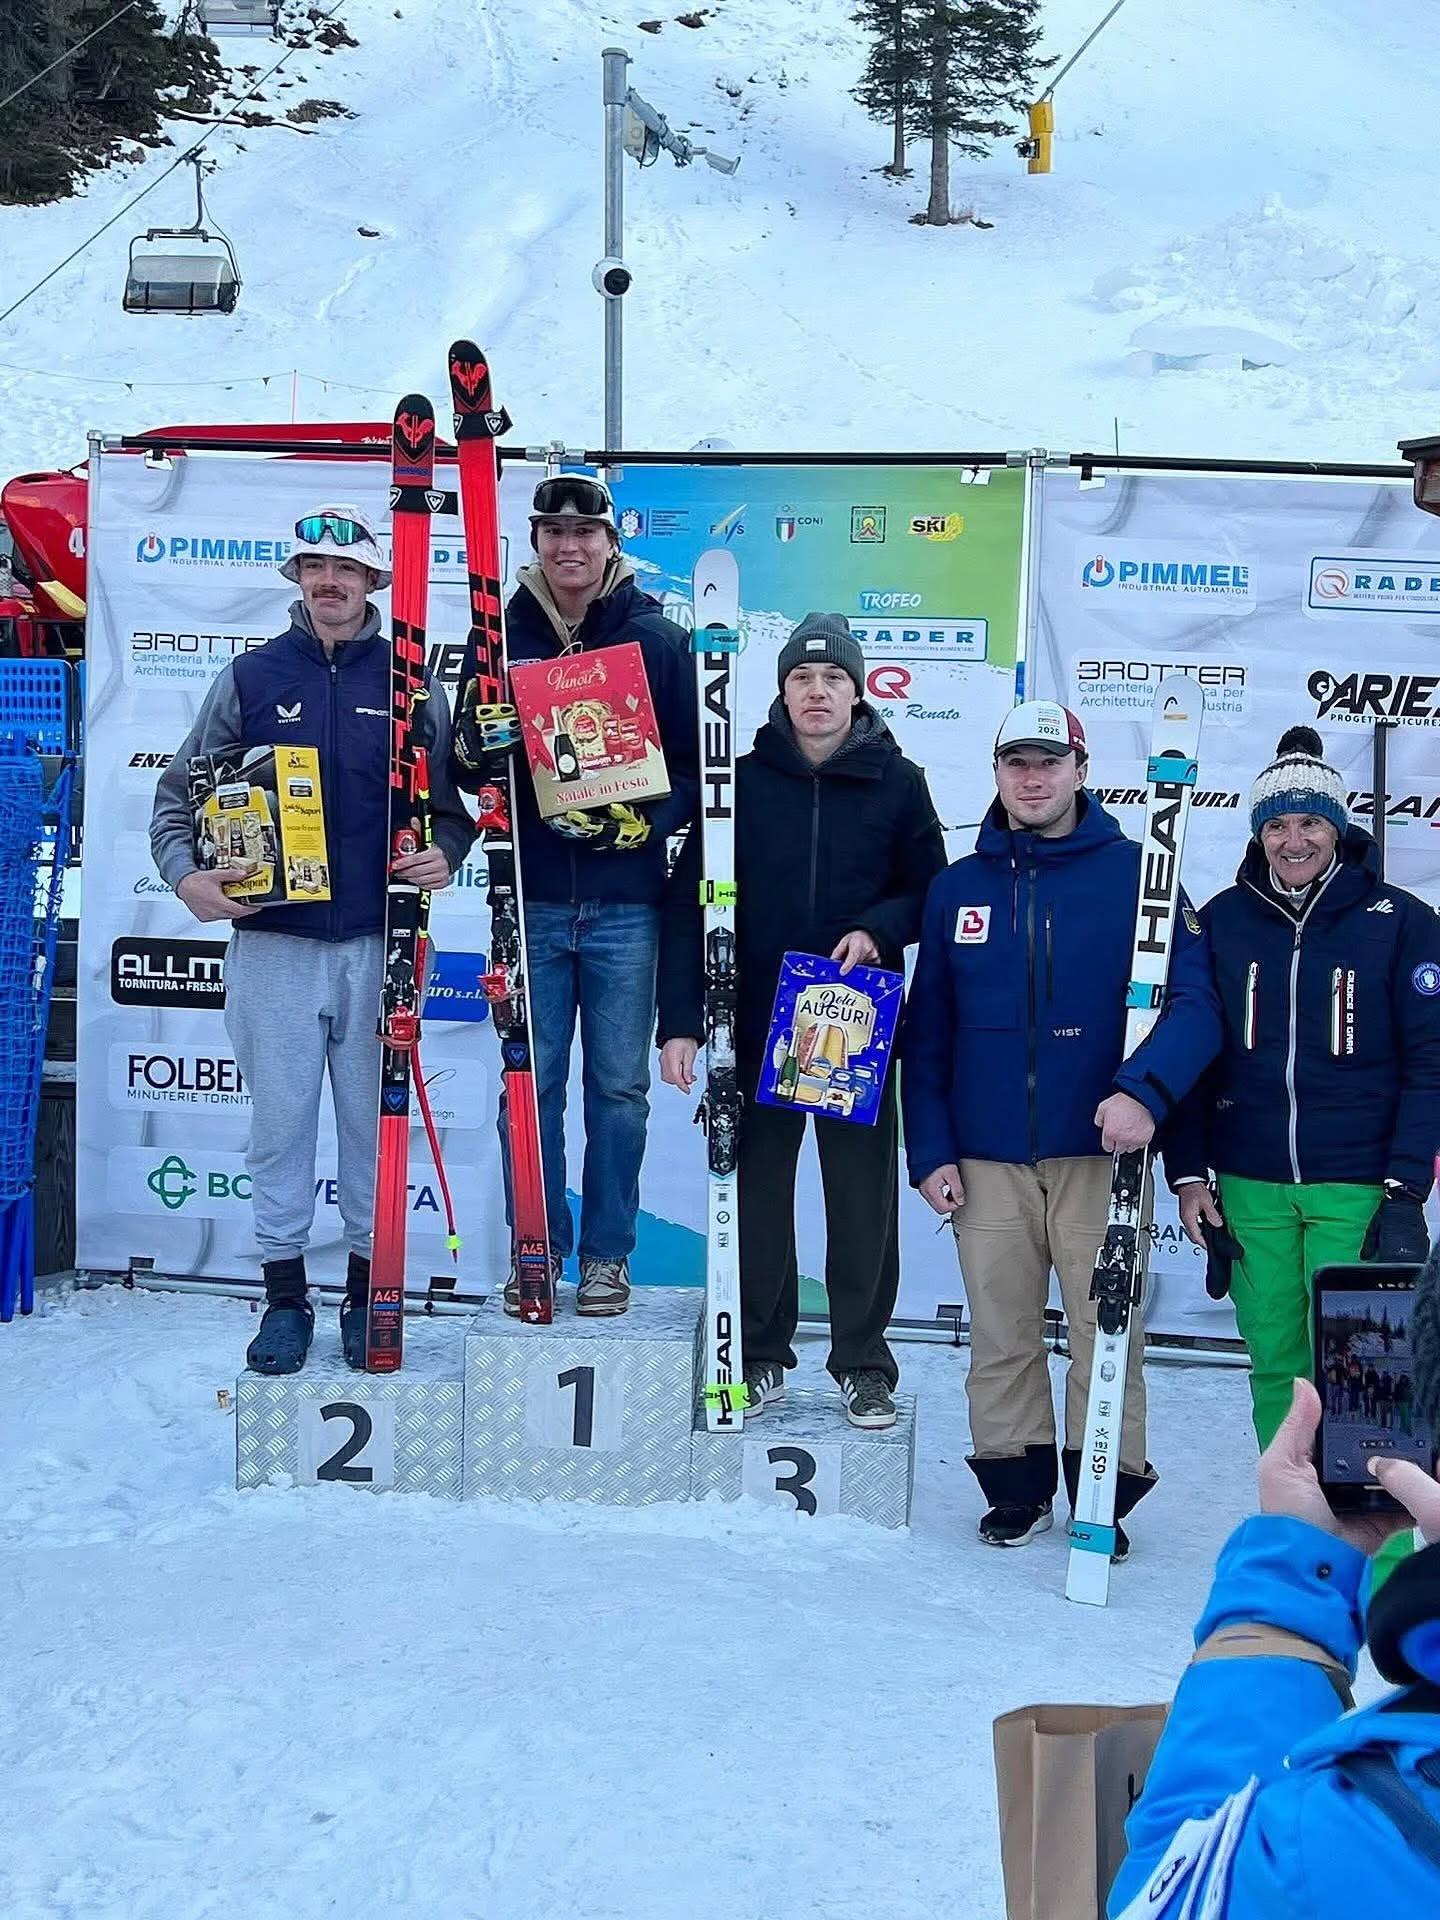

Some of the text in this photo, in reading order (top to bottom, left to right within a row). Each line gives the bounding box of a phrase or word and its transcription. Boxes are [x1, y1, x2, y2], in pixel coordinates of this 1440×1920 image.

[798, 517, 823, 526] CONI
[912, 520, 945, 532] SKI
[170, 537, 287, 562] PIMMEL
[169, 559, 224, 567] INDUSTRIAL
[1119, 561, 1248, 588] PIMMEL
[1118, 583, 1248, 595] INDUSTRIAL AUTOMATION
[861, 592, 922, 608] TROFEO
[850, 629, 976, 644] RADER
[131, 652, 202, 665] Carpenteria
[135, 665, 206, 678] Architettura
[1078, 681, 1153, 695] Carpenteria
[1223, 688, 1244, 701] per
[1320, 673, 1440, 718] ARIE
[905, 703, 961, 719] Renato
[1038, 726, 1060, 735] 2025
[556, 775, 649, 805] Natale in Festa
[118, 977, 179, 992] TORNITURA
[820, 990, 858, 1009] Dolci
[800, 1000, 870, 1025] AUGURI
[1346, 1013, 1354, 1023] DI
[127, 1089, 253, 1106] MINUTERIE TORNIT
[520, 1242, 545, 1255] A45
[374, 1290, 400, 1302] A45
[557, 1366, 596, 1448] 1
[316, 1402, 374, 1482] 2
[766, 1446, 817, 1516] 3
